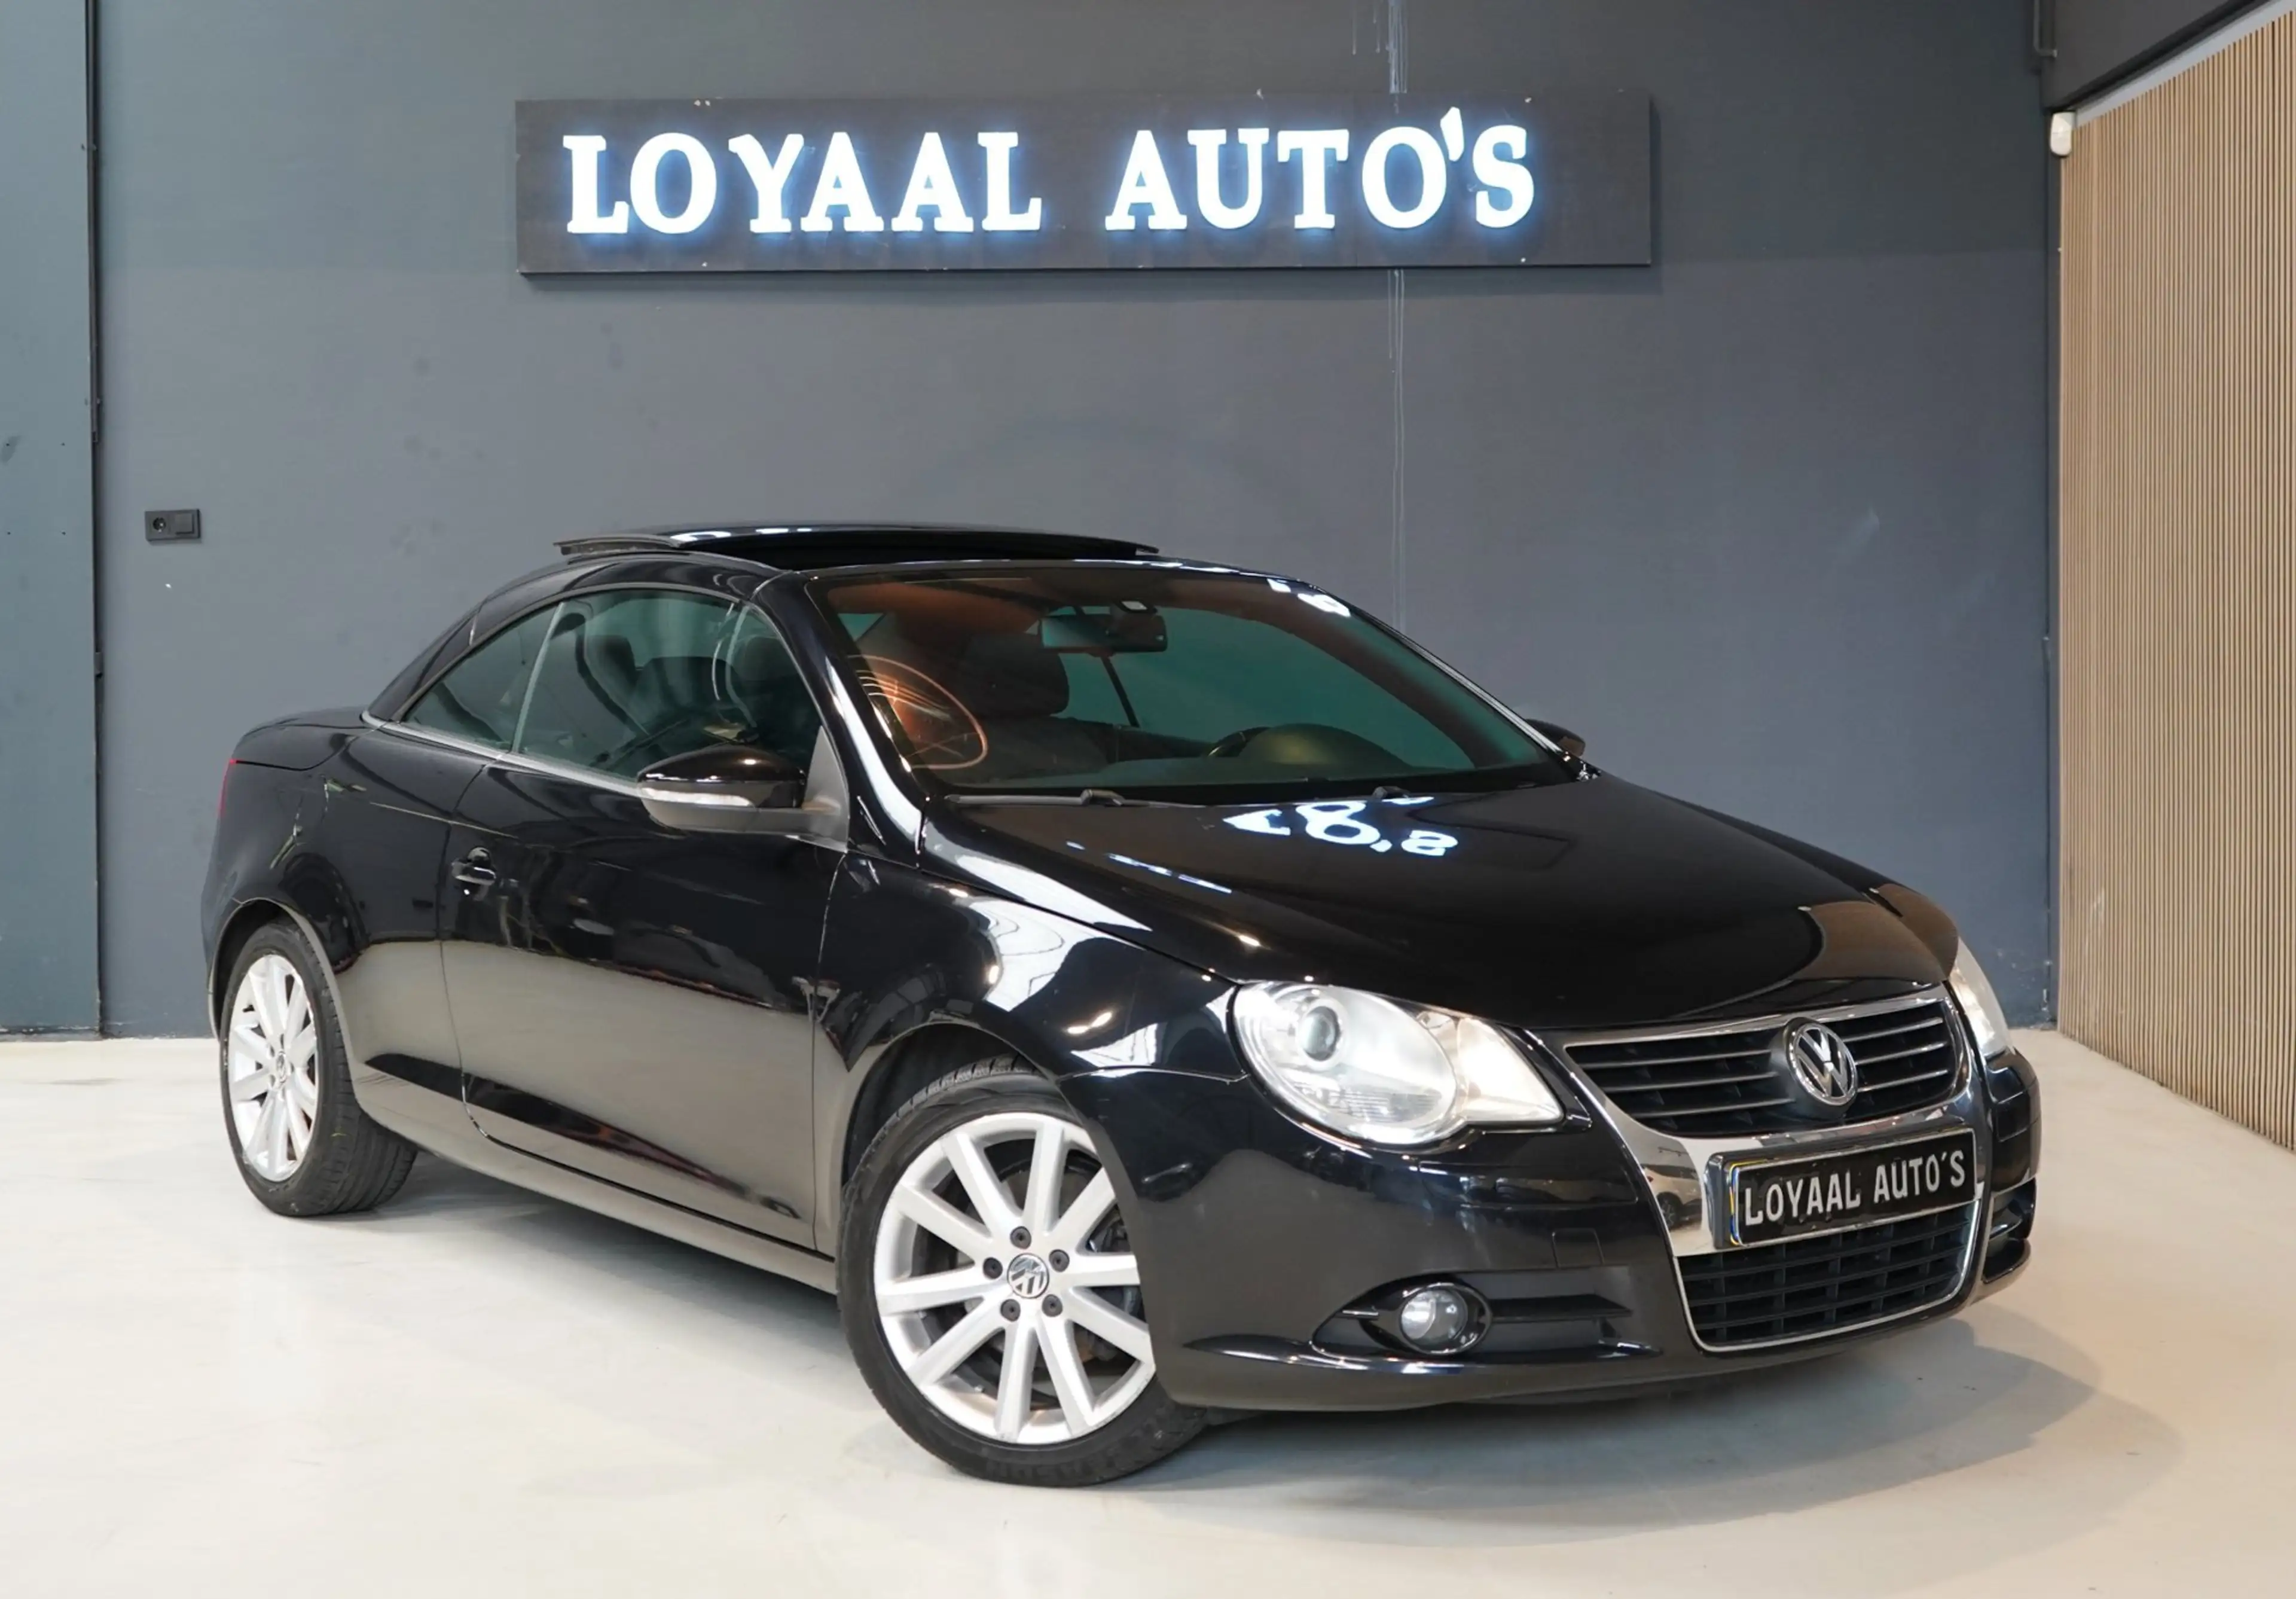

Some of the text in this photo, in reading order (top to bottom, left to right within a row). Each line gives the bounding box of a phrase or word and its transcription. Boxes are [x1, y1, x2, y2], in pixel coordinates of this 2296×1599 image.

[563, 108, 1533, 233] LOYAAL AUTO'S
[1745, 1171, 1861, 1226] LOYAAL
